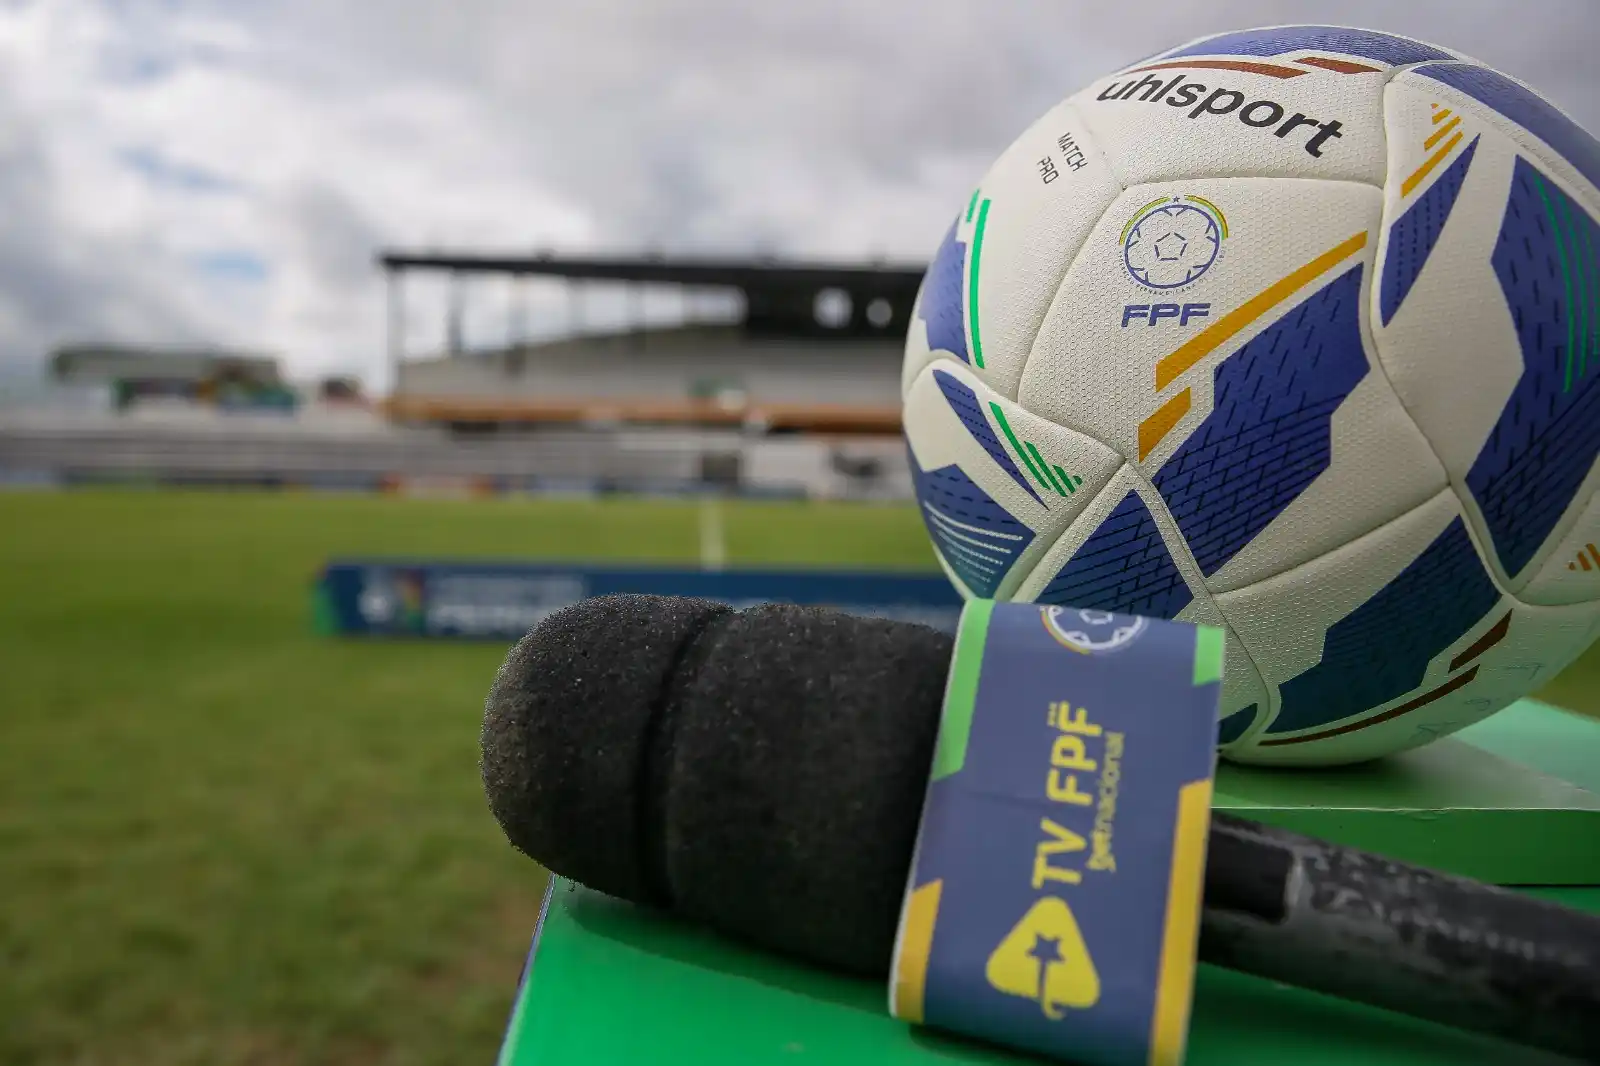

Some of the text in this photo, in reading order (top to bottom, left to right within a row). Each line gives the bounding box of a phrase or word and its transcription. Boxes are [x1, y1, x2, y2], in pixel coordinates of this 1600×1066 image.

[1096, 73, 1343, 158] uhlsport
[1037, 156, 1059, 184] PRO
[1058, 132, 1088, 171] MATCH
[1120, 302, 1212, 328] FPF
[1031, 701, 1103, 889] TV FPF
